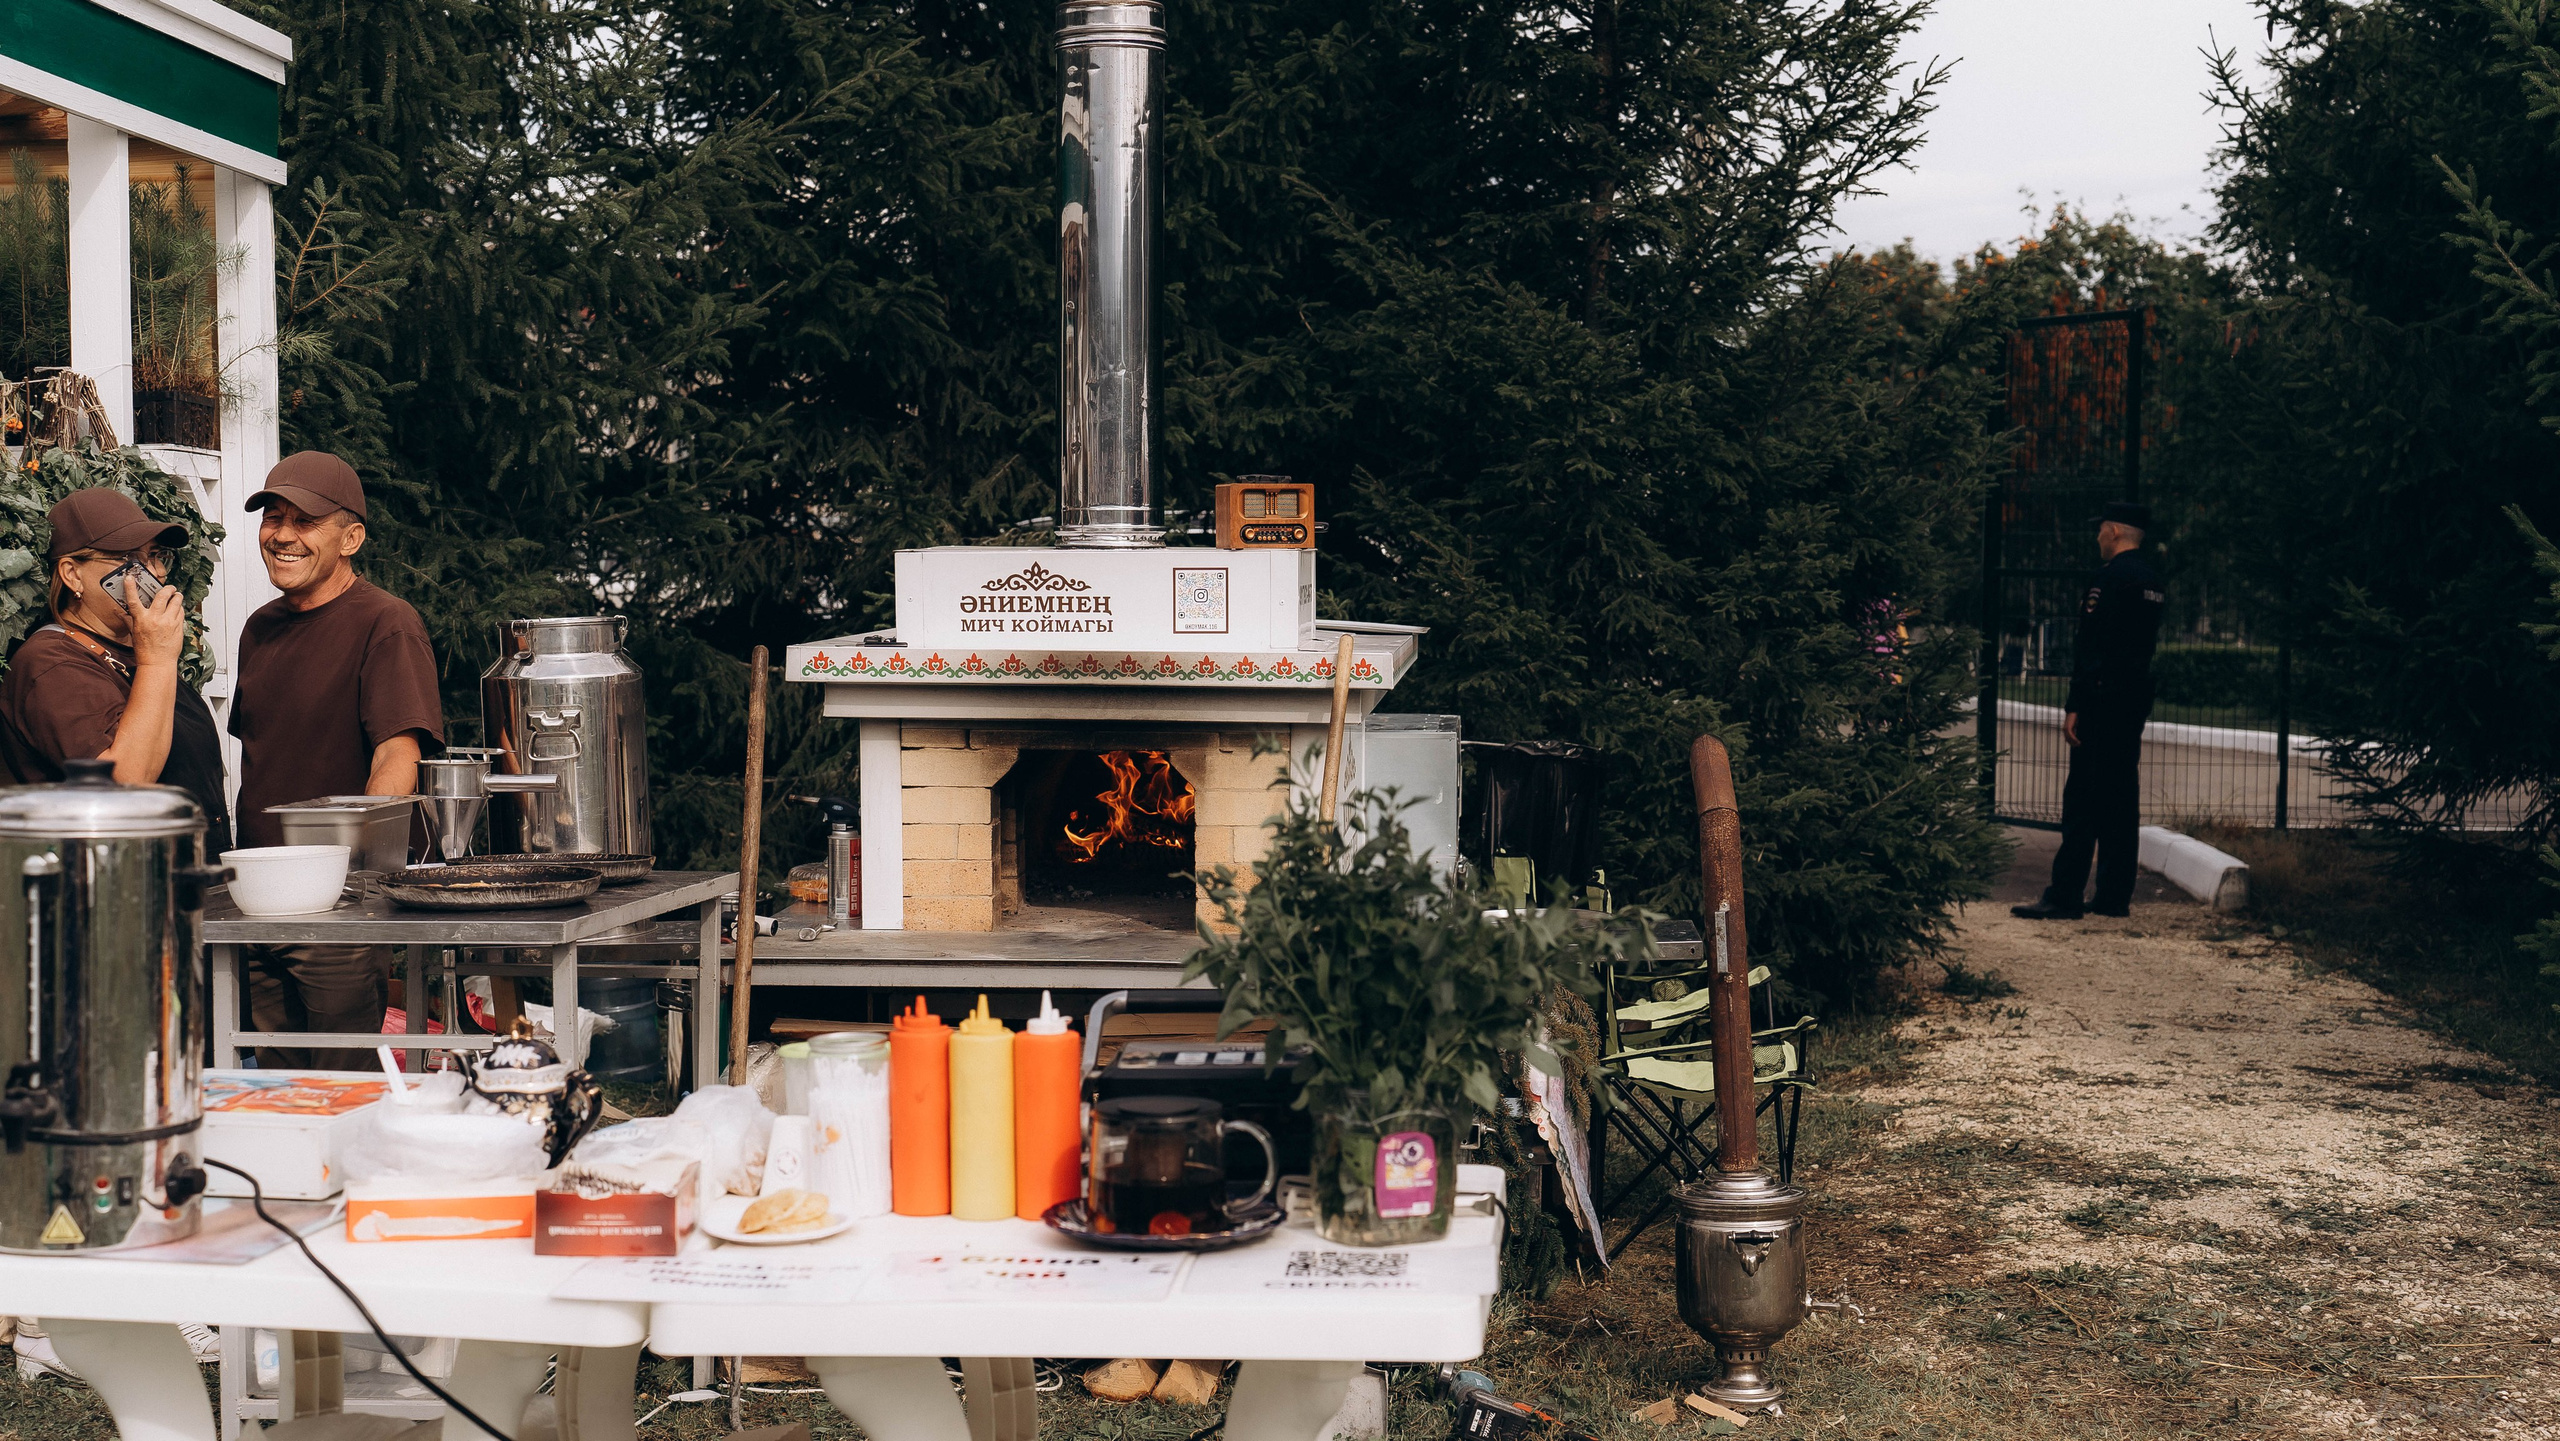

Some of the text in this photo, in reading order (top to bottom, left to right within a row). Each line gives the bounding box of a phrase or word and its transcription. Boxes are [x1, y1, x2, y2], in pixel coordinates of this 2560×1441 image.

[960, 595, 1113, 616] ӘНИЕМНЕҢ
[960, 615, 1114, 633] МИЧ КОЙМАГЫ
